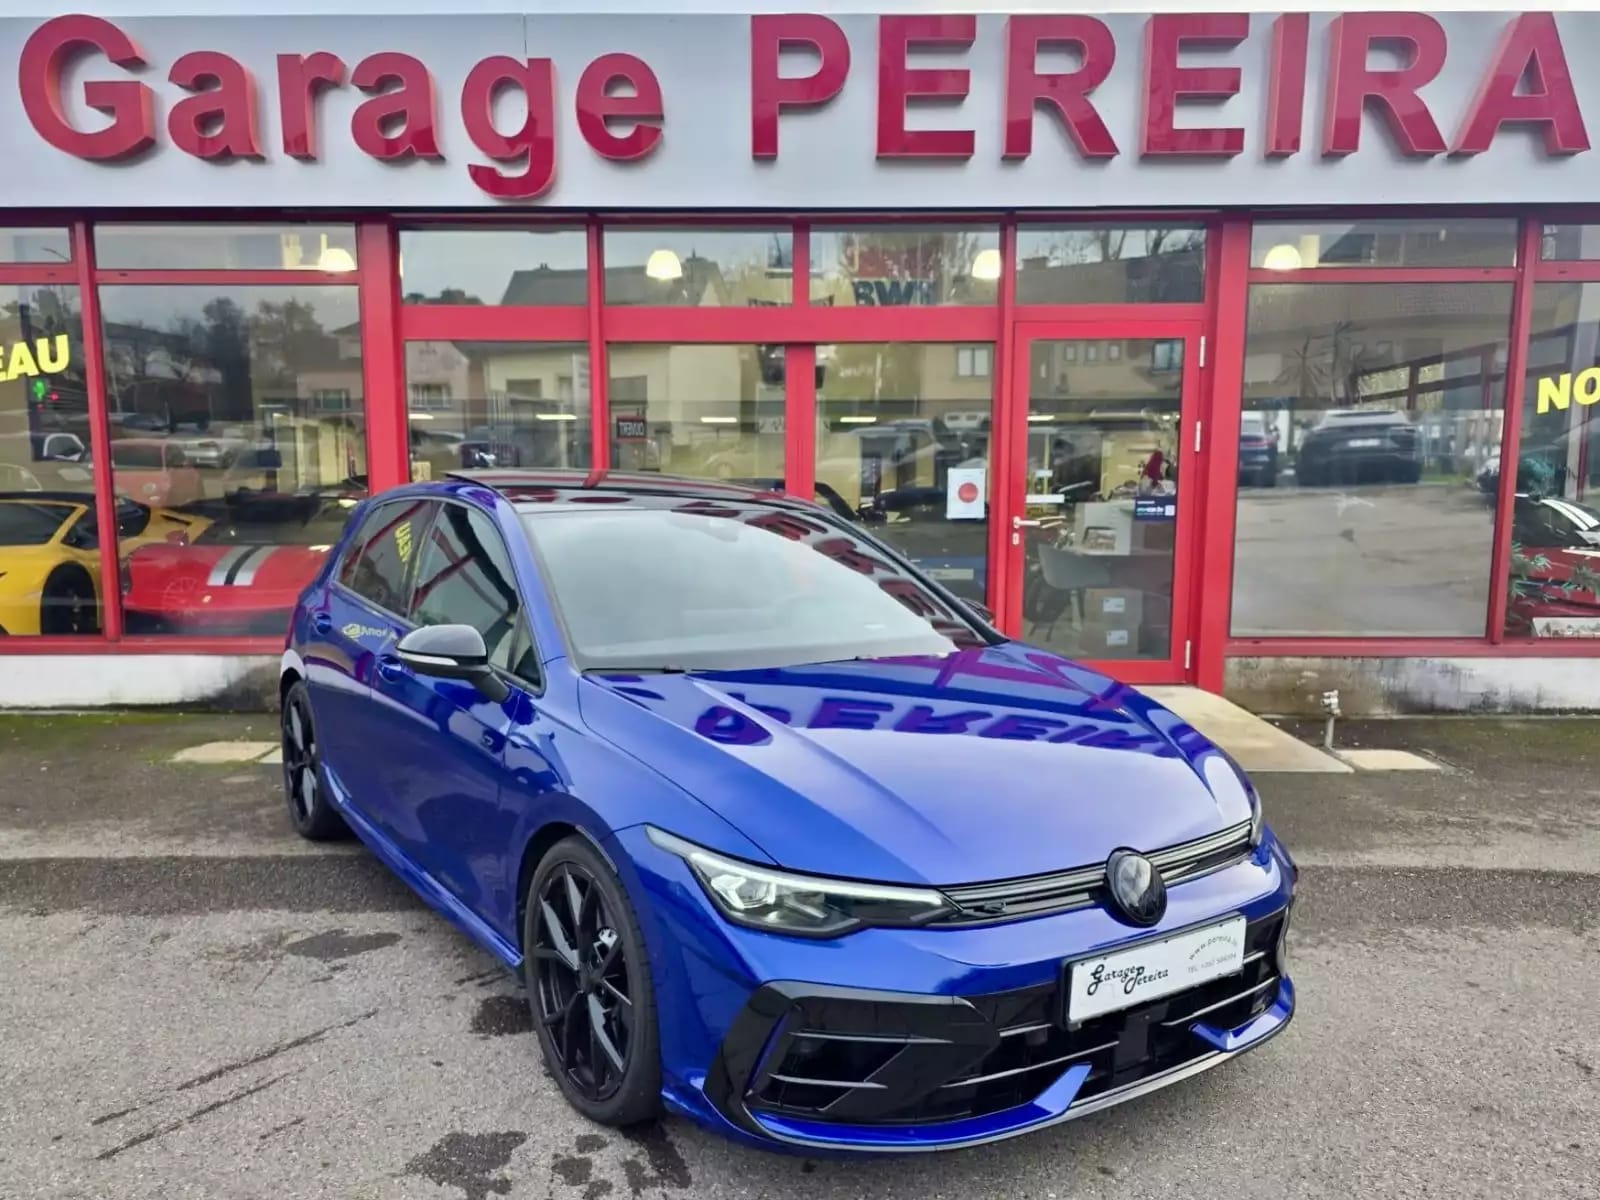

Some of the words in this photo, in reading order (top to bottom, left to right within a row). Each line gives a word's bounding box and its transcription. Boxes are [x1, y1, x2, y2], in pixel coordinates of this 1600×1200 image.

[18, 14, 664, 199] Garage
[751, 11, 1591, 160] PEREIRA
[1087, 964, 1136, 996] Garage
[1124, 966, 1169, 994] Pereira
